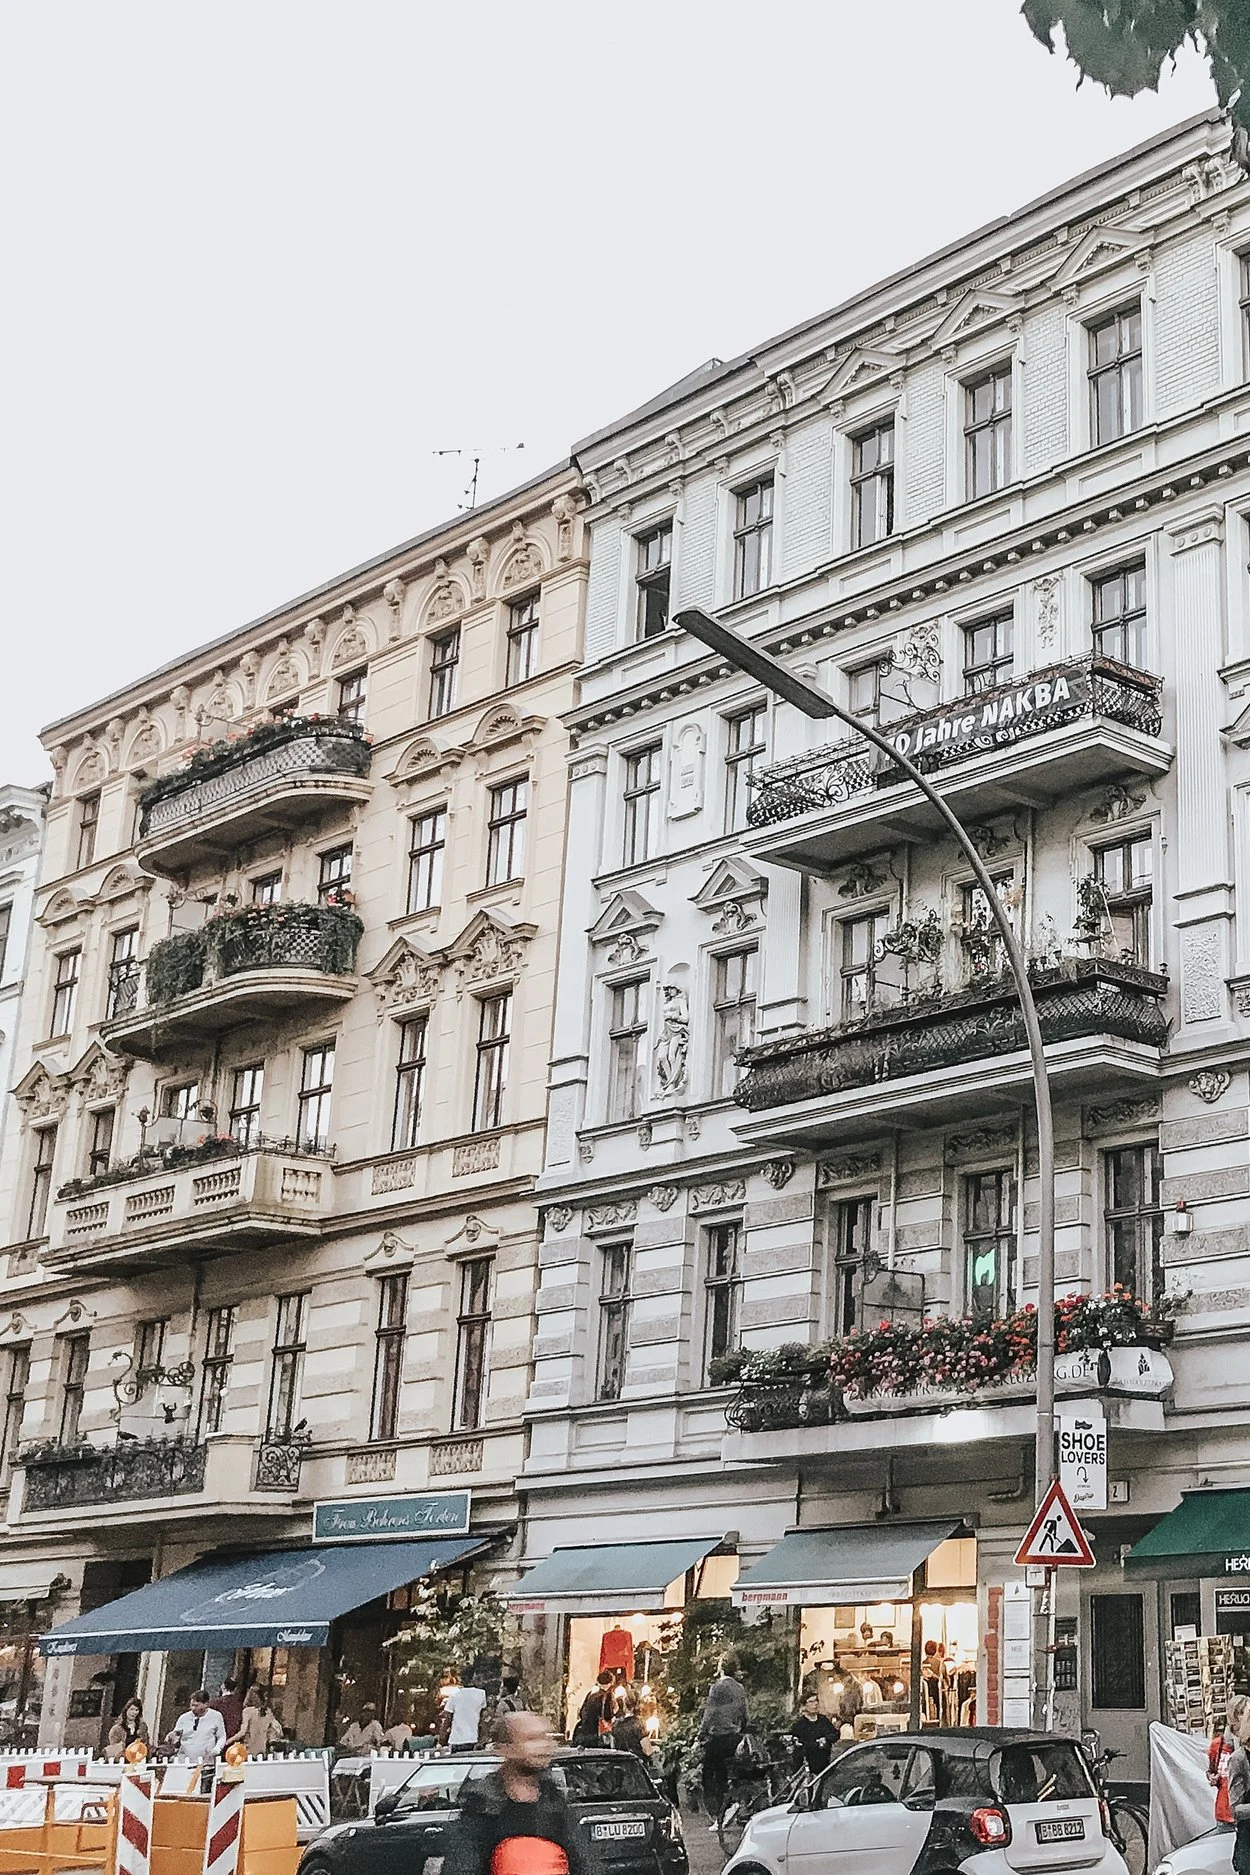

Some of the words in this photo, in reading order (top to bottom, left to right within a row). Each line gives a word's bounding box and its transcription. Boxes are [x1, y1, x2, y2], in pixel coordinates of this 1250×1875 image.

[915, 714, 976, 755] Jahre
[980, 675, 1071, 728] NAKBA
[1061, 1431, 1105, 1452] SHOE
[1061, 1451, 1105, 1465] LOVERS
[741, 1591, 788, 1603] bergmann
